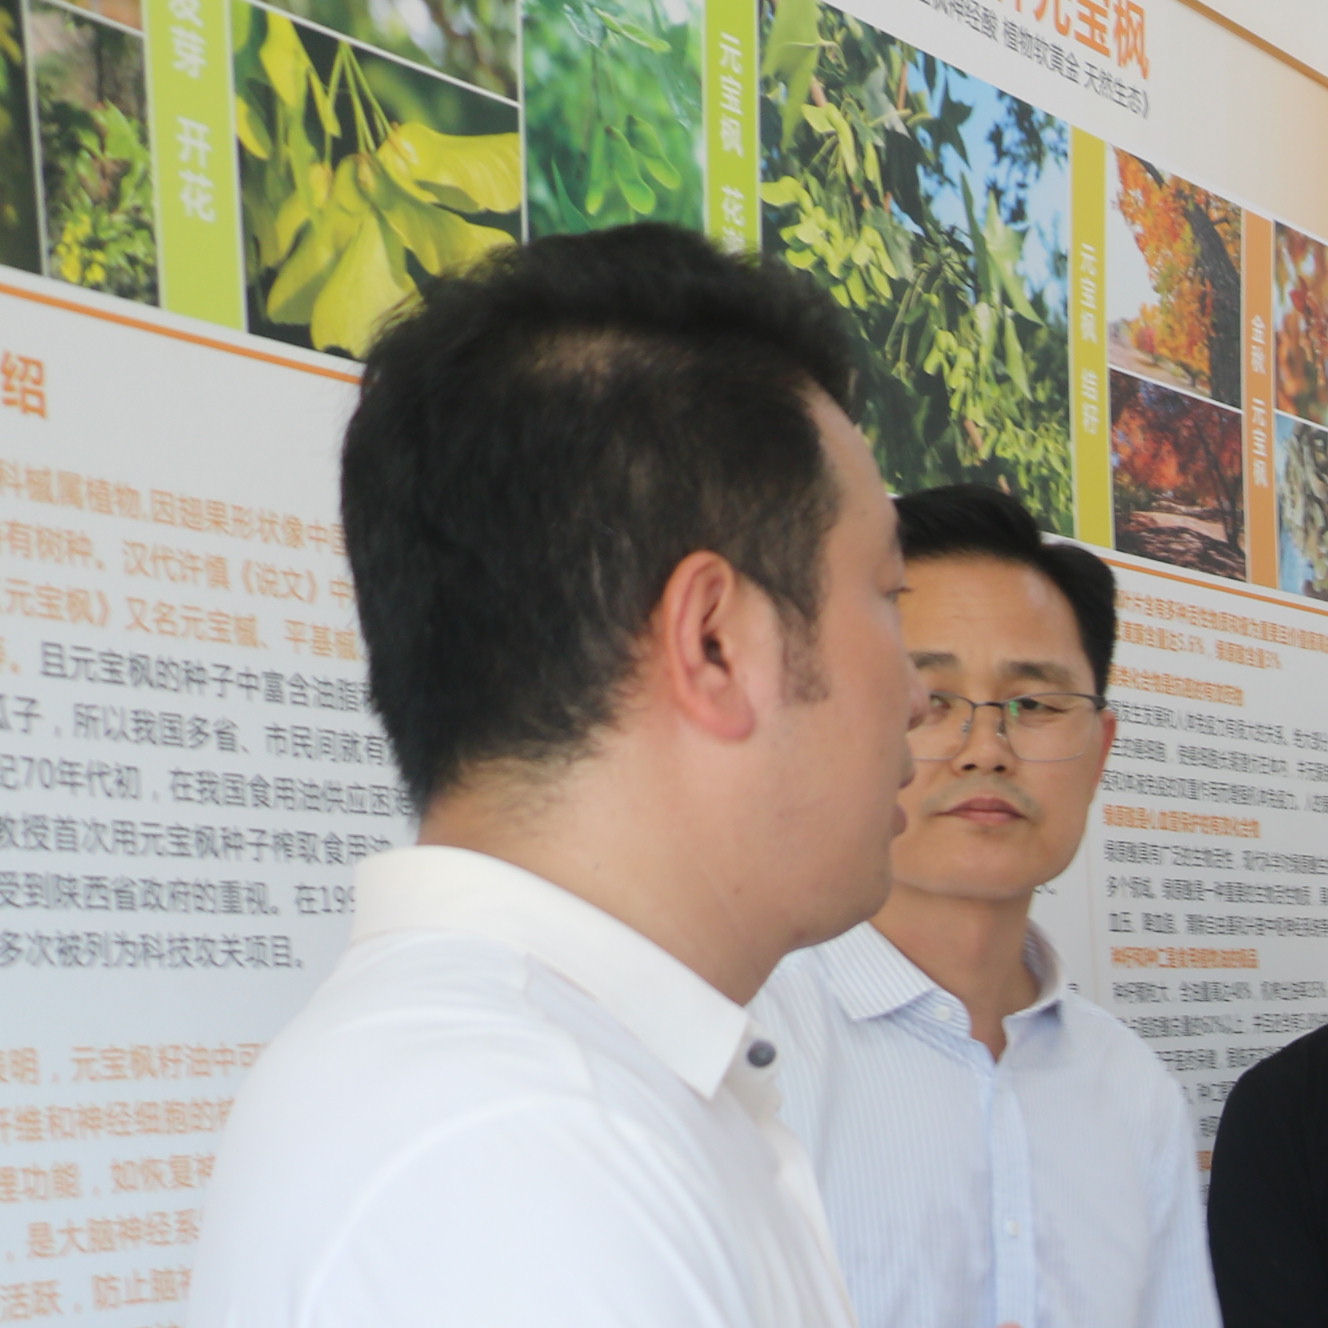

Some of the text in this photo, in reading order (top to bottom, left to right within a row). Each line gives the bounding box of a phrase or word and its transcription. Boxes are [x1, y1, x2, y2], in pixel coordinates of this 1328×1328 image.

[718, 30, 745, 158] 元宝枫
[1003, 20, 1080, 85] 植物软黄金
[176, 115, 218, 224] 开花
[1079, 241, 1098, 345] 元宝枫
[1, 350, 48, 419] 绍
[1251, 397, 1269, 489] 元宝枫
[0, 634, 371, 714] 。且元宝枫的种子中富含油脂
